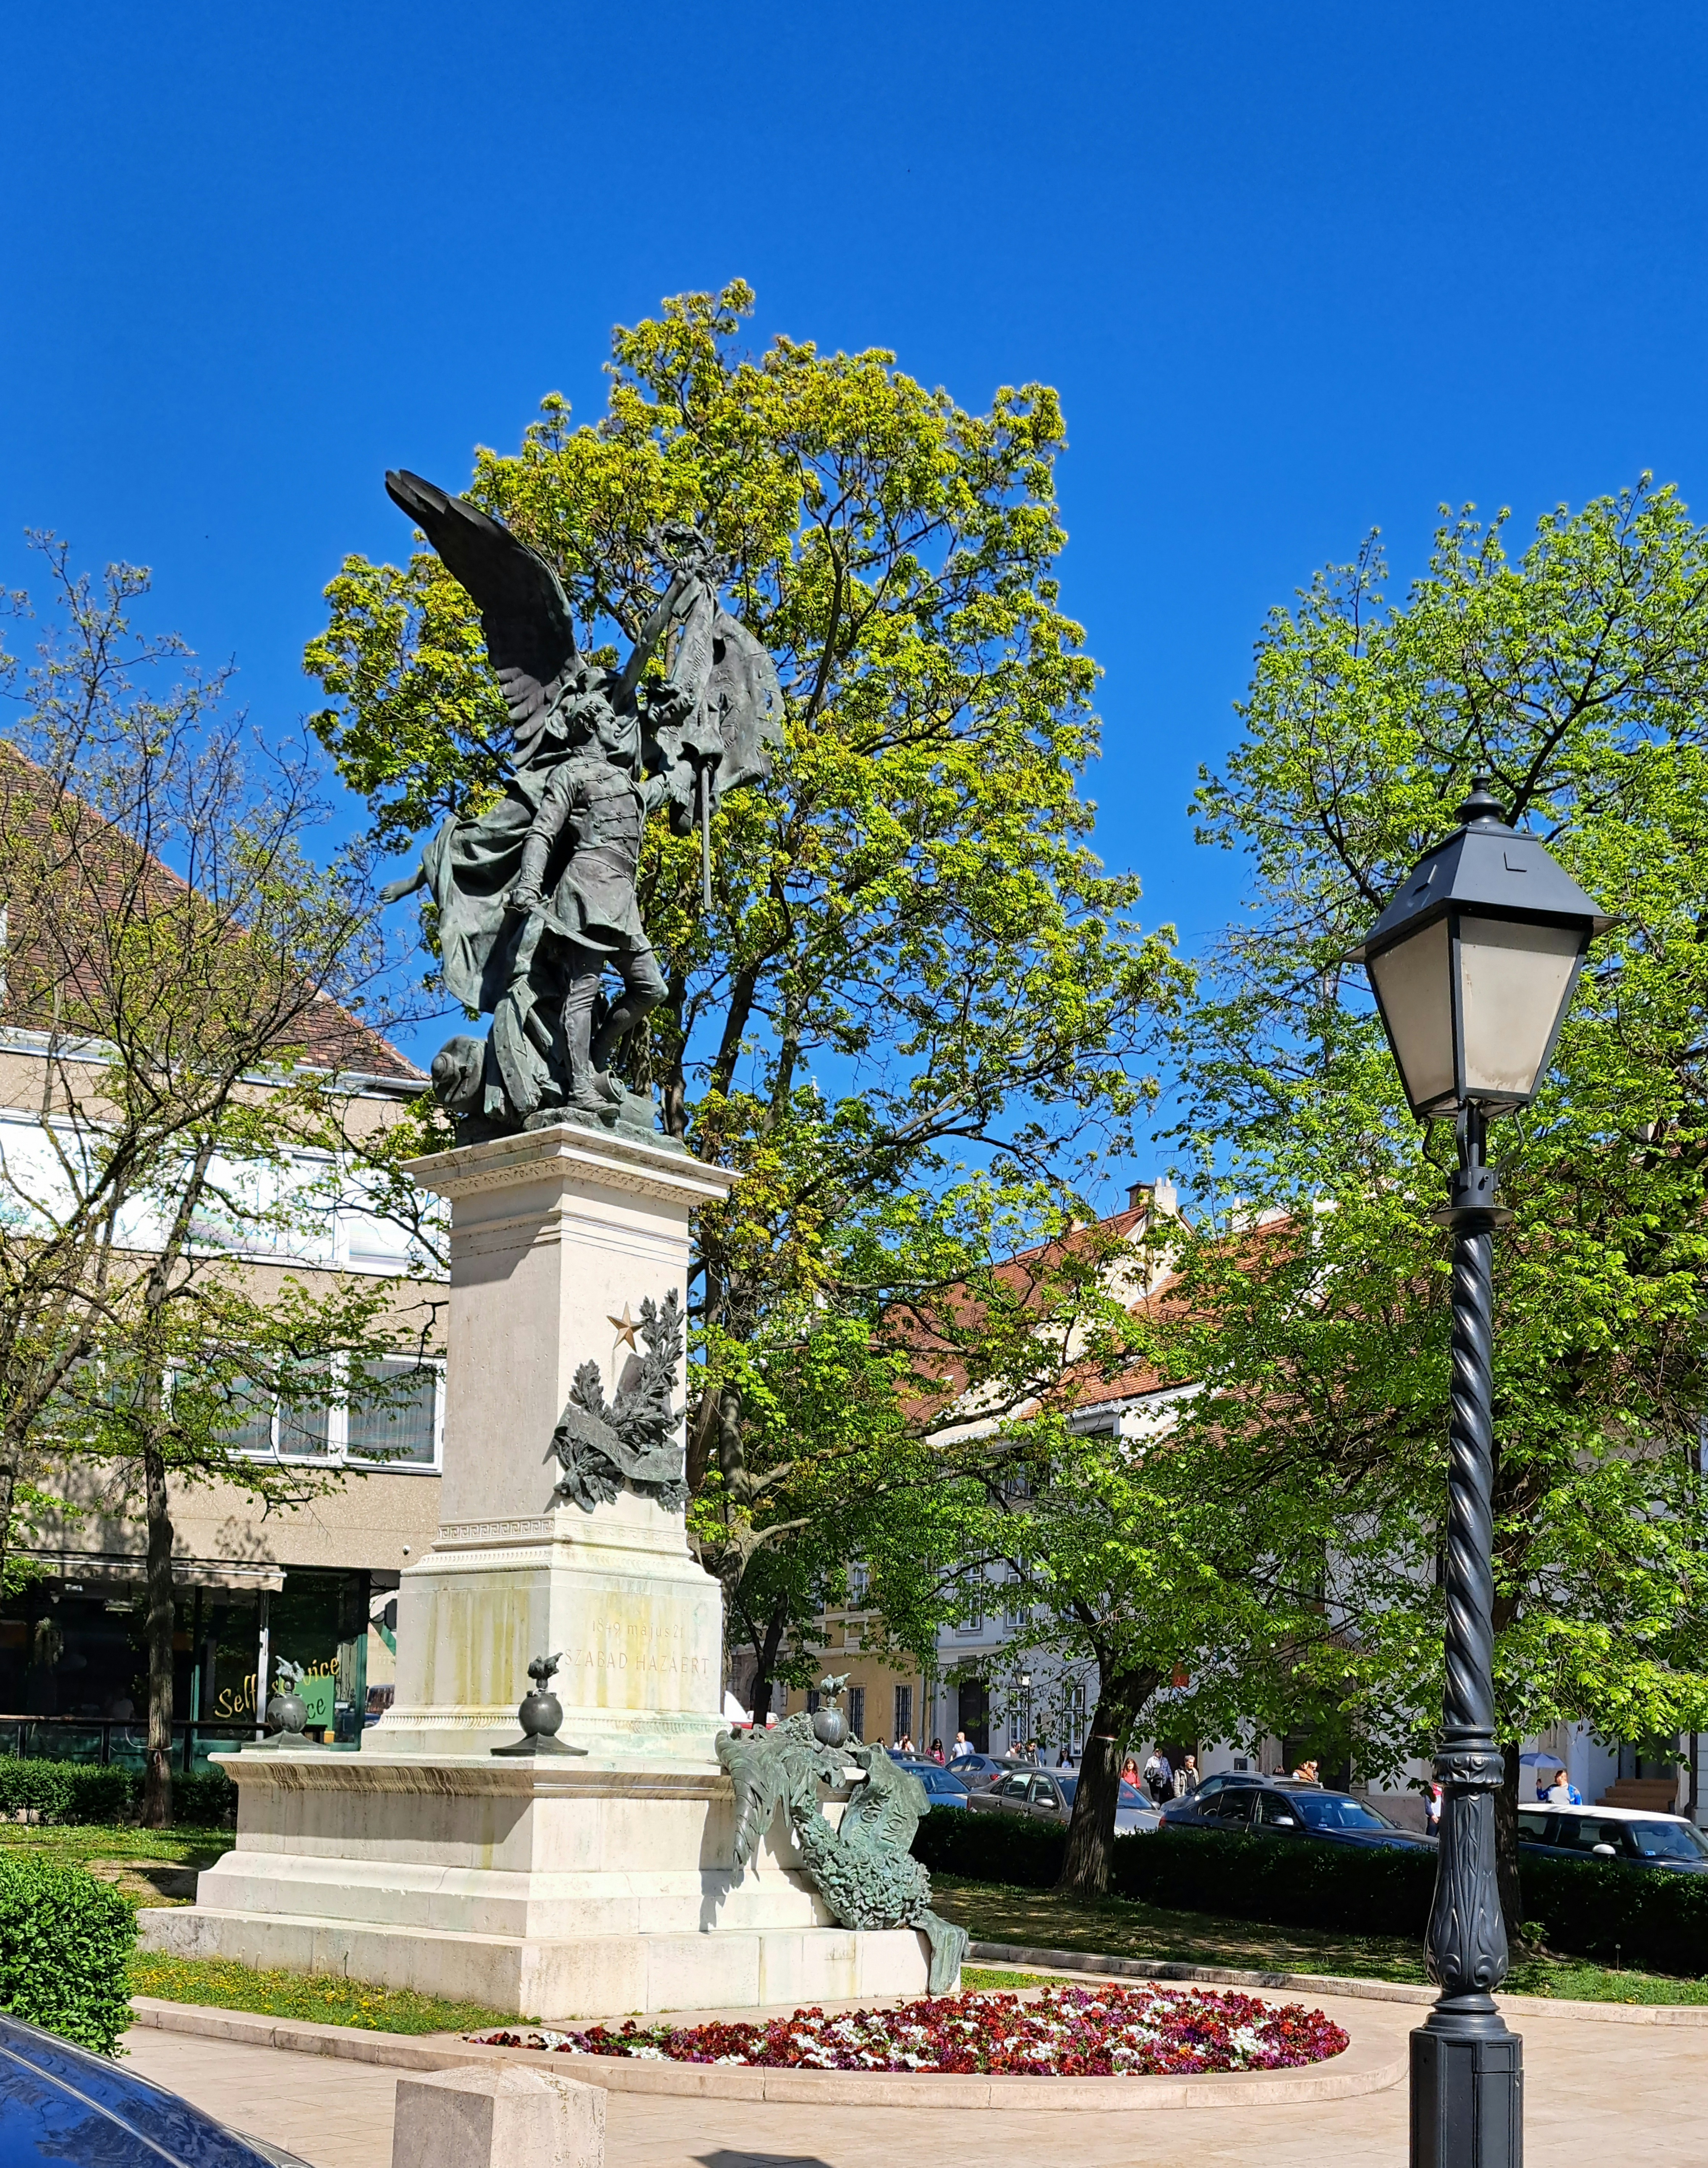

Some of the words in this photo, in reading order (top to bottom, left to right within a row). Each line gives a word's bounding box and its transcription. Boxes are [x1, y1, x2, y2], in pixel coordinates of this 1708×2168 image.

[593, 1617, 620, 1635] 1849
[627, 1623, 670, 1642] május
[673, 1624, 683, 1638] 21
[565, 1649, 628, 1669] SZABAD
[636, 1651, 709, 1674] HAZÁÉRT
[214, 1673, 258, 1718] Self
[853, 1785, 894, 1847] MAGYAR
